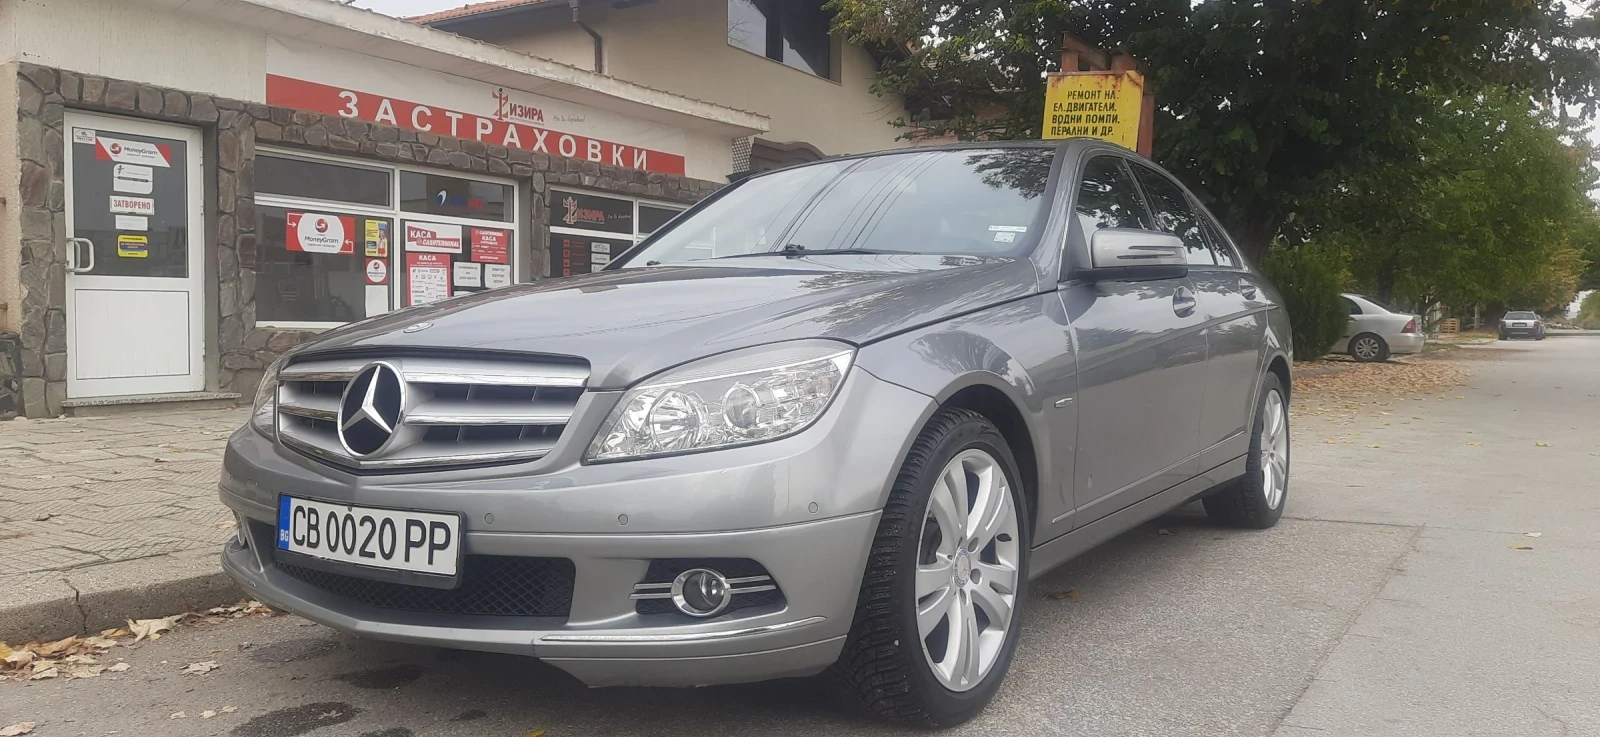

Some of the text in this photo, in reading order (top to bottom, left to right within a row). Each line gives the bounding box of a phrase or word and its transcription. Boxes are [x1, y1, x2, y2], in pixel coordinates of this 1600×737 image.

[1067, 90, 1102, 100] РЕМОНТ
[1052, 114, 1082, 125] ВОДНИ
[338, 91, 648, 171] ЗАСТРАХОВКИ
[1051, 126, 1114, 137] ПЕРАЛНИ И ДР.
[123, 146, 158, 155] MoneyGram
[113, 199, 151, 210] ЗАТВОРЕНО
[304, 235, 339, 244] MoneyGram
[410, 229, 432, 239] КАСА
[422, 239, 460, 248] CASHTERMINAL
[280, 529, 289, 542] BG
[326, 511, 397, 560] 0020
